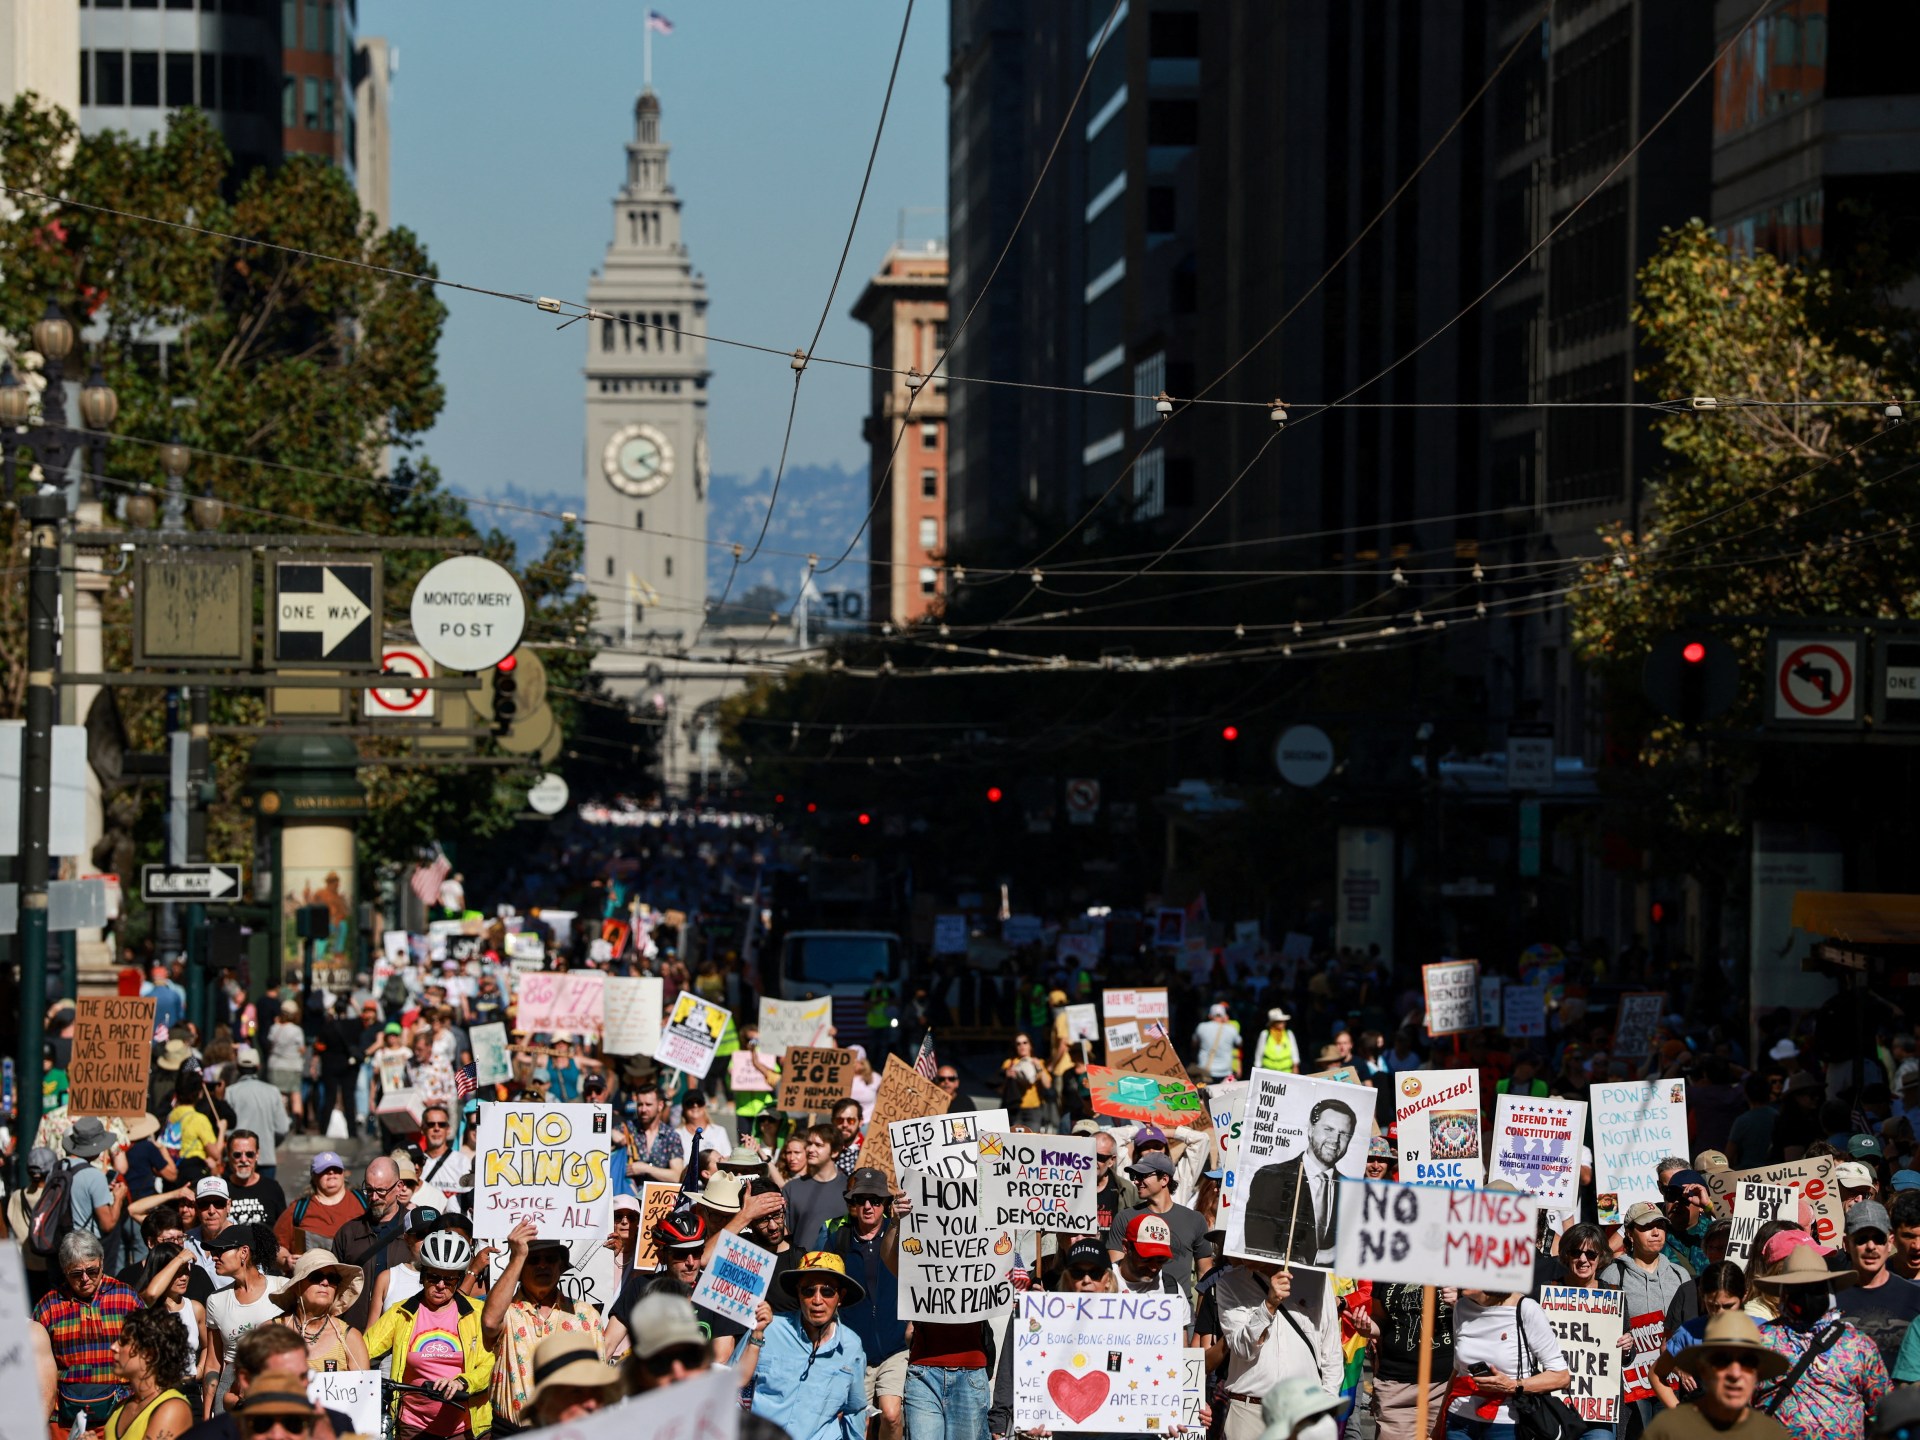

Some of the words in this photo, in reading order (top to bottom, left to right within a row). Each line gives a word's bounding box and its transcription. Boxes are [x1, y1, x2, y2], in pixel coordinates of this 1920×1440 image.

[423, 592, 512, 606] MONTGOMERY
[282, 606, 315, 619] ONE
[328, 605, 361, 619] WAY
[440, 623, 495, 637] POST
[1889, 678, 1917, 688] ONE
[154, 875, 178, 891] ONE
[184, 875, 210, 888] WAY
[1106, 994, 1120, 1005] ARE
[1123, 993, 1134, 1004] WE
[79, 1000, 102, 1017] THE
[104, 1001, 155, 1020] BOSTON
[533, 1016, 554, 1028] NO
[555, 1014, 602, 1030] KINGS
[77, 1023, 102, 1040] TEA
[109, 1023, 150, 1040] PARTY
[75, 1042, 106, 1060] WAS
[118, 1042, 141, 1059] THE
[792, 1050, 851, 1065] DEFUND
[74, 1062, 144, 1084] ORIGINAL
[792, 1065, 839, 1083] ICE
[785, 1086, 800, 1096] NO
[804, 1086, 844, 1096] HUMAN
[889, 1059, 949, 1106] PATRIOTISM
[1261, 1080, 1286, 1096] Would
[70, 1087, 89, 1110] NO
[121, 1089, 145, 1110] RALLY
[784, 1097, 796, 1107] IS
[803, 1099, 834, 1110] ILLEG
[880, 1086, 912, 1113] STAND
[883, 1074, 921, 1107] MEANS
[922, 1101, 939, 1115] TO
[1259, 1093, 1275, 1108] YOU
[1397, 1075, 1473, 1122] RADICALIZED!
[1602, 1085, 1662, 1105] POWER
[874, 1111, 888, 1127] IT
[1256, 1107, 1271, 1121] buy
[1273, 1112, 1278, 1121] a
[1512, 1114, 1548, 1125] DEFEND
[1551, 1117, 1567, 1127] THE
[1599, 1106, 1668, 1126] CONCEDES
[503, 1112, 572, 1148] NO
[890, 1122, 934, 1149] LETS
[1254, 1121, 1274, 1133] used
[1277, 1127, 1303, 1136] couch
[1505, 1126, 1572, 1140] CONSTITUTION
[1601, 1125, 1671, 1147] NOTHING
[1252, 1131, 1273, 1145] from
[1275, 1135, 1290, 1148] this
[899, 1143, 932, 1168] GET
[1002, 1145, 1035, 1164] NO
[1041, 1149, 1094, 1170] KINGS
[1250, 1144, 1274, 1157] man?
[1406, 1151, 1419, 1161] BY
[1503, 1152, 1530, 1160] AGAINST
[1541, 1155, 1568, 1163] ENEMIES
[1604, 1149, 1671, 1169] WITHOUT
[993, 1163, 1010, 1176] IN
[1016, 1165, 1083, 1183] AMERICA
[1417, 1163, 1462, 1178] BASIC
[1499, 1160, 1525, 1168] FOREIGN
[1541, 1164, 1572, 1172] DOMESTIC
[484, 1149, 609, 1203] KINGS
[1608, 1174, 1658, 1192] DEMA
[649, 1190, 672, 1205] No
[1007, 1183, 1083, 1198] PROTECT
[1745, 1184, 1791, 1204] BUILT
[232, 1198, 260, 1207] REBEL
[486, 1191, 557, 1210] JUSTICE
[1027, 1197, 1068, 1213] OUR
[1362, 1183, 1418, 1224] NO
[1447, 1188, 1530, 1225] KINGS
[509, 1212, 546, 1224] FOR
[562, 1206, 600, 1228] ALL
[997, 1207, 1096, 1231] DEMOCRACY
[1758, 1202, 1781, 1220] BY
[910, 1213, 928, 1233] IF
[1145, 1225, 1168, 1236] 49ERS
[926, 1238, 989, 1258] NEVER
[1360, 1230, 1410, 1265] NO
[726, 1248, 741, 1266] THIS
[740, 1254, 747, 1268] IS
[746, 1258, 762, 1276] WHAT
[719, 1261, 758, 1290] DEMOCRACY
[918, 1263, 996, 1282] TEXTED
[712, 1276, 736, 1298] LOOKS
[734, 1287, 753, 1306] LIKE
[910, 1286, 957, 1314] WAR
[961, 1281, 1010, 1314] PLANS
[1025, 1295, 1065, 1319] NO
[1076, 1297, 1172, 1322] KINGS
[1541, 1287, 1625, 1317] AMERICA!
[1018, 1333, 1042, 1350] NO
[324, 1377, 357, 1404] King
[1020, 1377, 1041, 1388] WE
[1020, 1395, 1043, 1404] THE
[1110, 1394, 1180, 1406] AMERICA
[1016, 1409, 1063, 1420] PEOPLE
